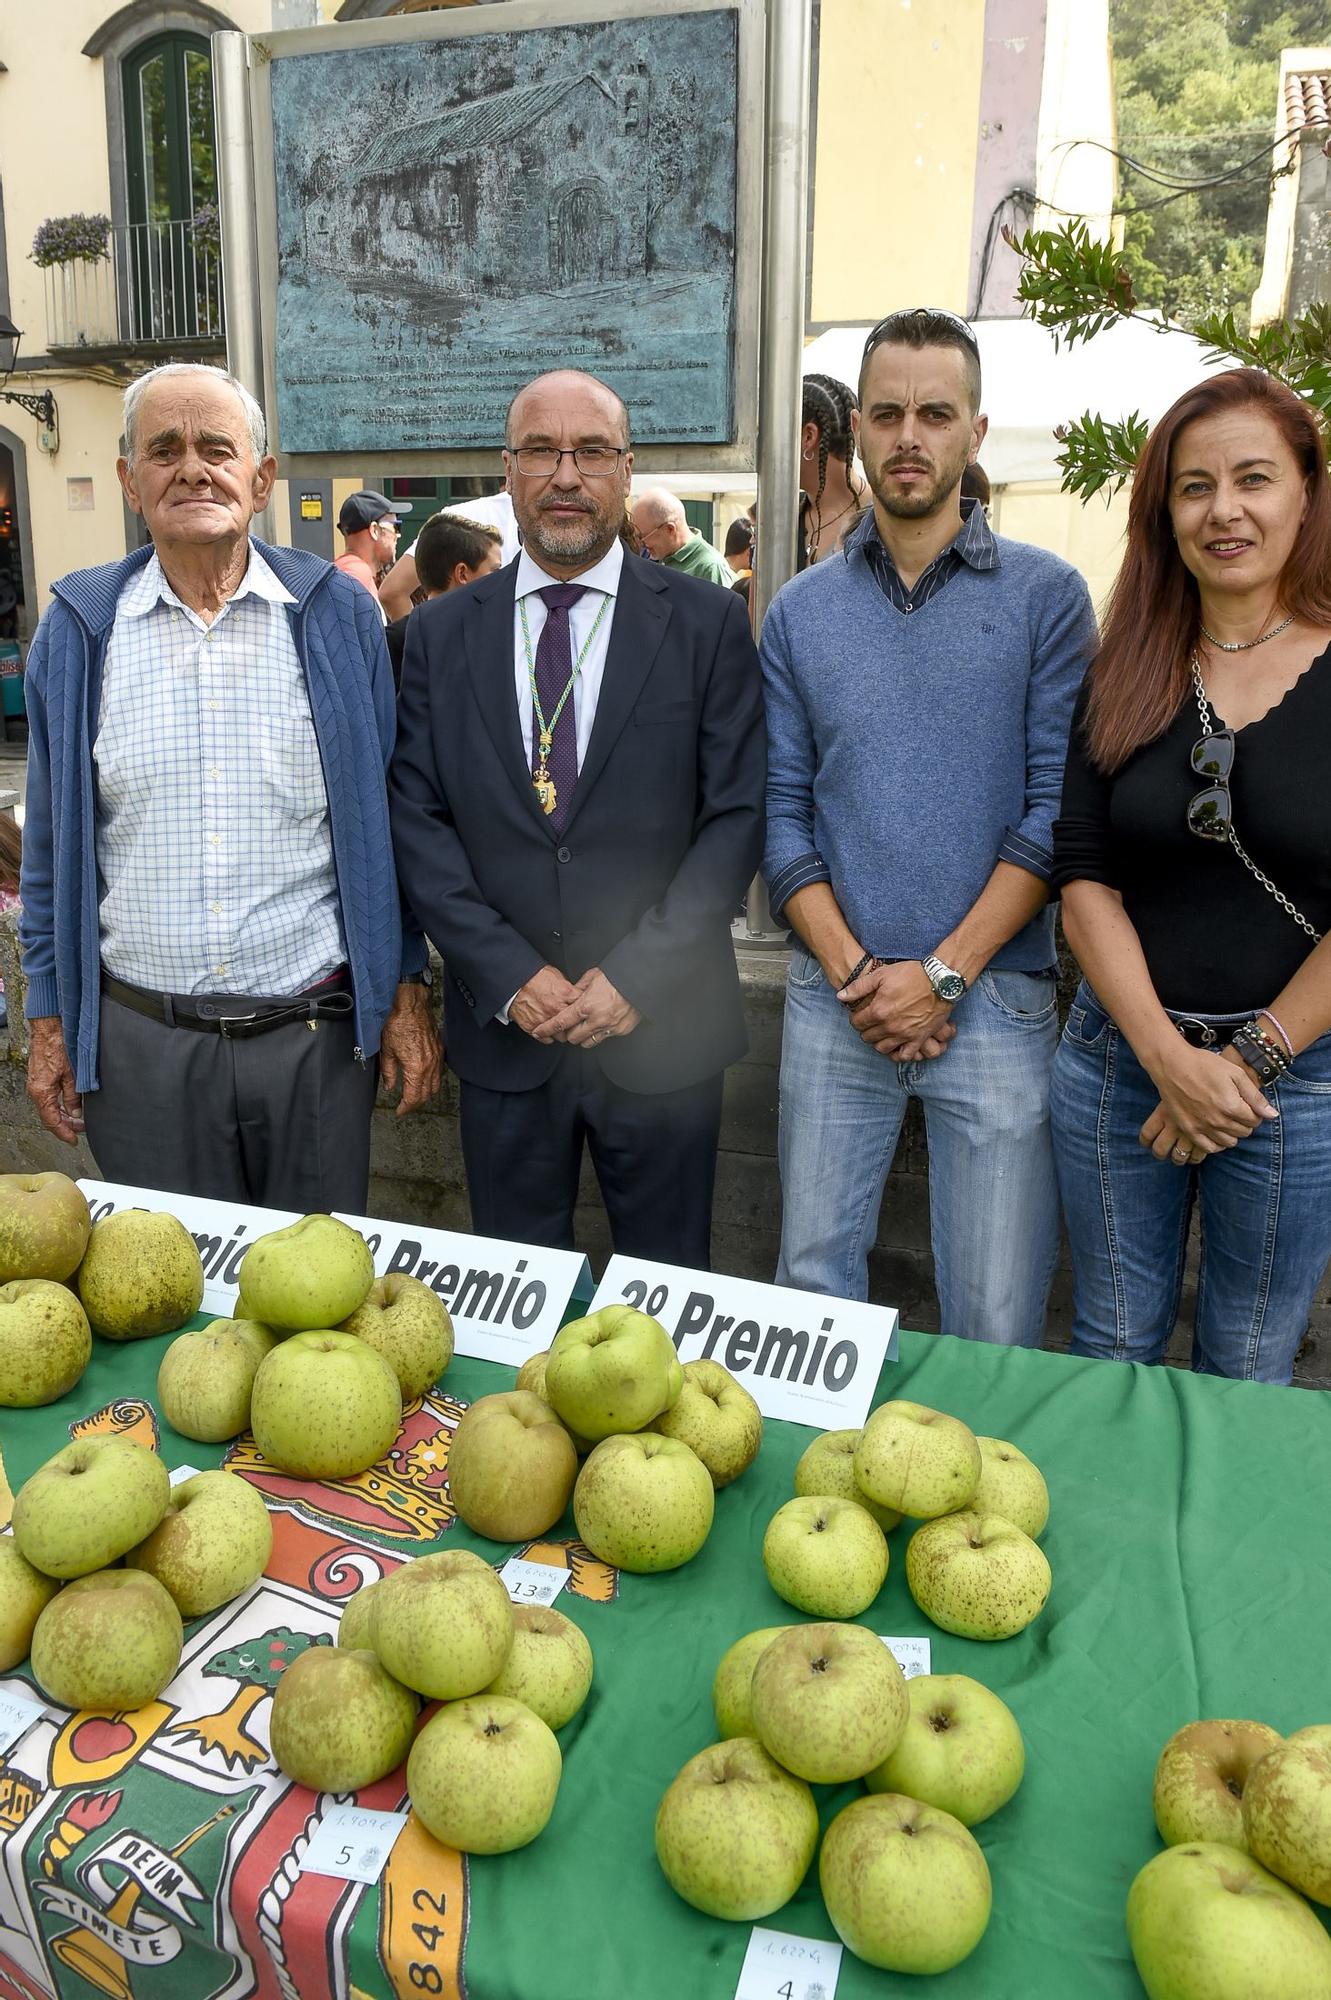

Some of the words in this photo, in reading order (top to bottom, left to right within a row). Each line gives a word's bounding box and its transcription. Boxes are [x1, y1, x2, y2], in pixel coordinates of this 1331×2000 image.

[672, 1291, 859, 1393] Premio
[510, 1582, 538, 1597] 13
[119, 1840, 184, 1898] DEUM
[335, 1845, 354, 1865] 5
[64, 1898, 165, 1957] TIMETE
[777, 1981, 793, 2000] 4
